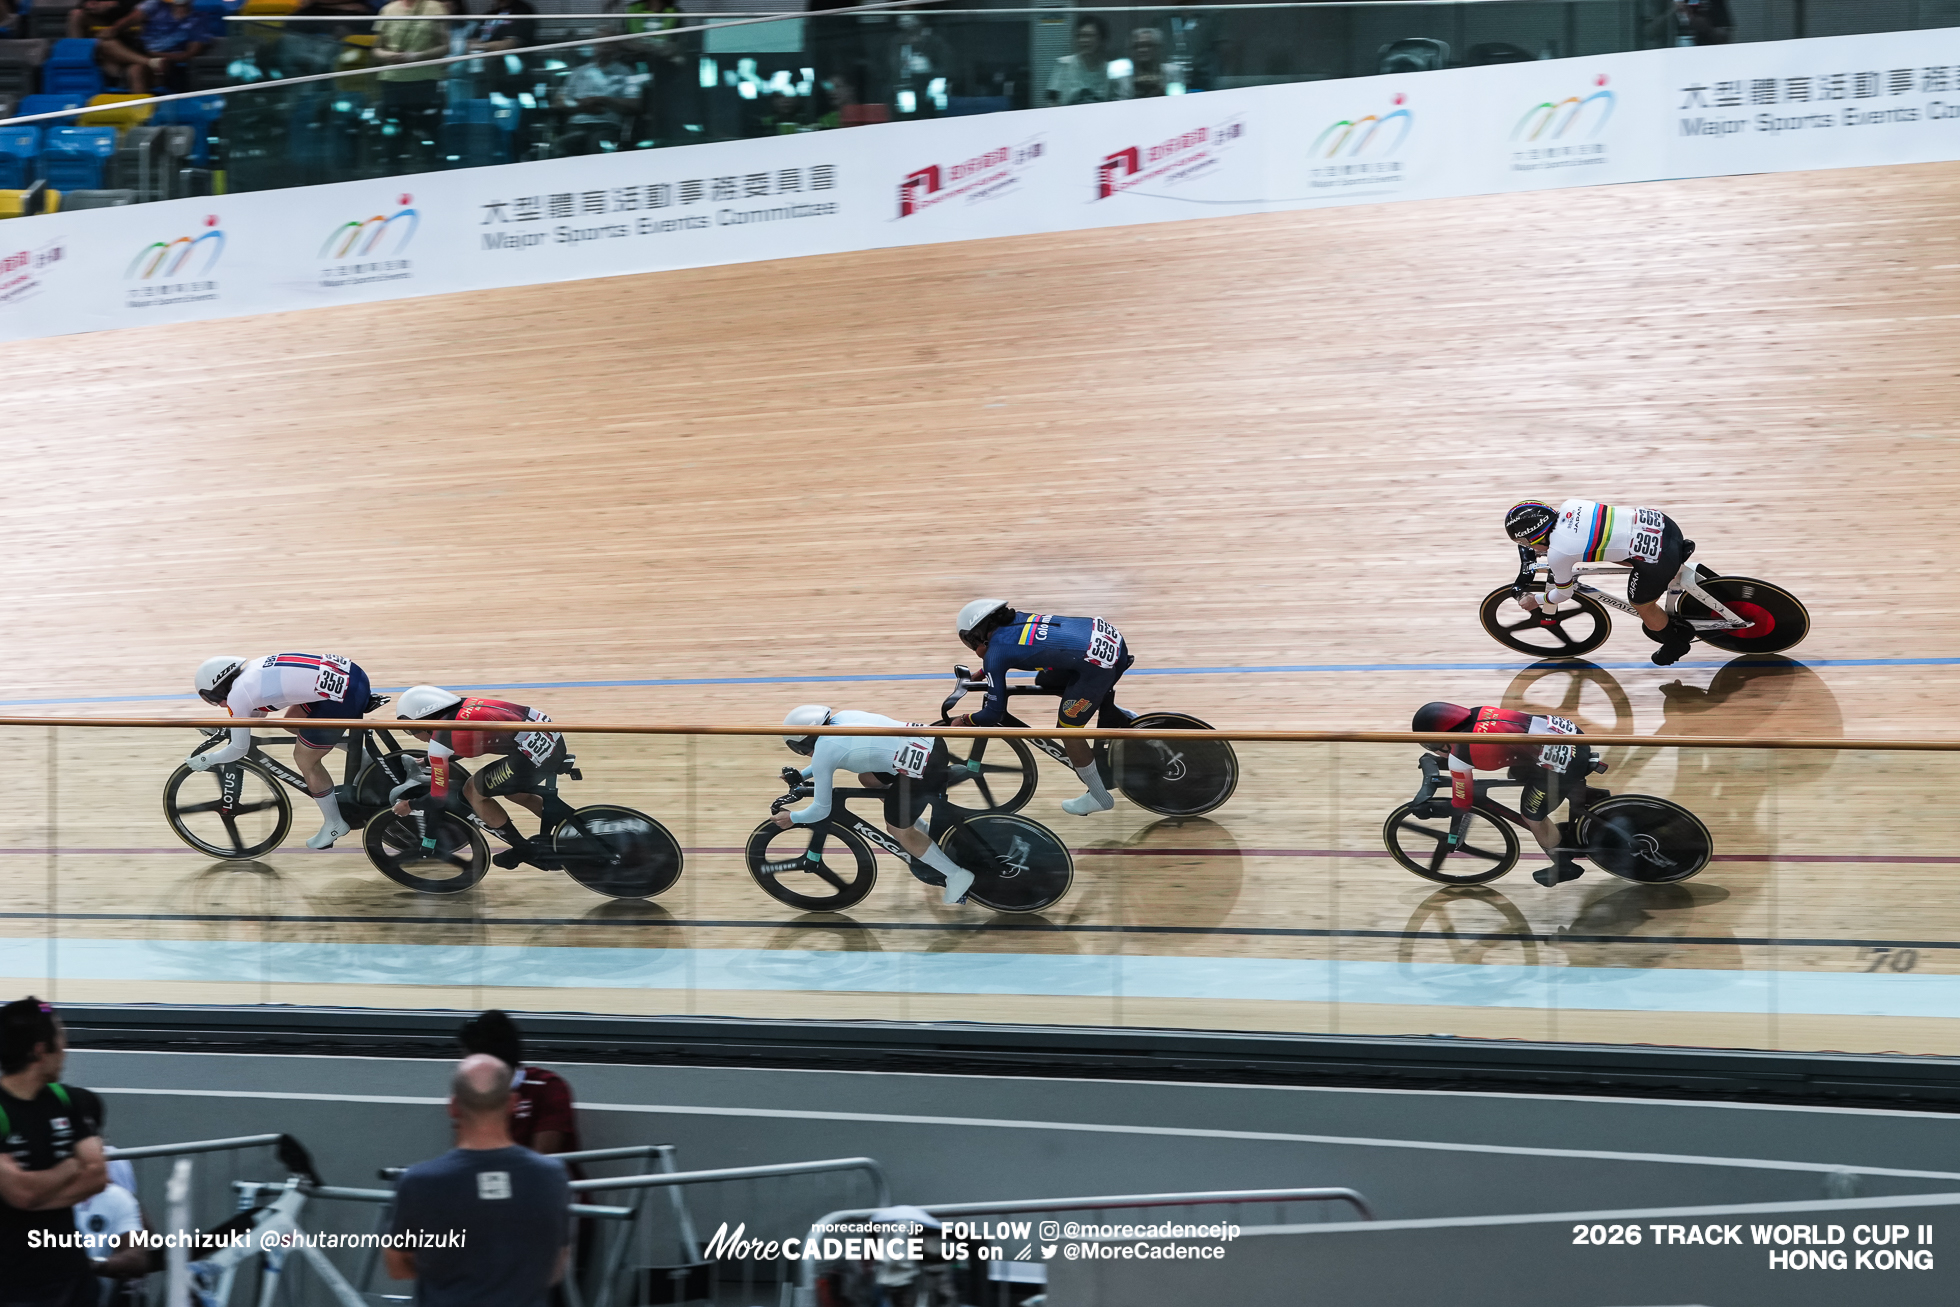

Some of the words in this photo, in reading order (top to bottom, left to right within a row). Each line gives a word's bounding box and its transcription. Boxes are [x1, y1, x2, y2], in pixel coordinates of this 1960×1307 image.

[1680, 117, 1748, 138] Major
[1754, 112, 1835, 136] Sports
[1840, 107, 1921, 126] Events
[481, 230, 547, 251] Major
[553, 223, 630, 247] Sports
[635, 214, 711, 235] Events
[716, 201, 840, 226] Committee
[1514, 515, 1549, 539] Kabuto
[1574, 506, 1583, 533] JAPAN
[1633, 532, 1659, 556] 393
[1629, 571, 1639, 598] JAPAN
[1092, 638, 1115, 662] 339
[212, 662, 236, 685] LAZER
[320, 670, 345, 694] 358
[527, 732, 552, 757] 337
[1030, 738, 1073, 768] OGA
[1543, 745, 1569, 765] 333
[898, 746, 924, 770] 419
[259, 757, 308, 789] hope
[434, 767, 445, 787] ANTA
[485, 761, 514, 789] CHINA
[223, 772, 235, 809] LOTUS
[1455, 782, 1465, 799] ANTA
[1525, 785, 1546, 814] CHINA
[853, 822, 911, 864] KOGA
